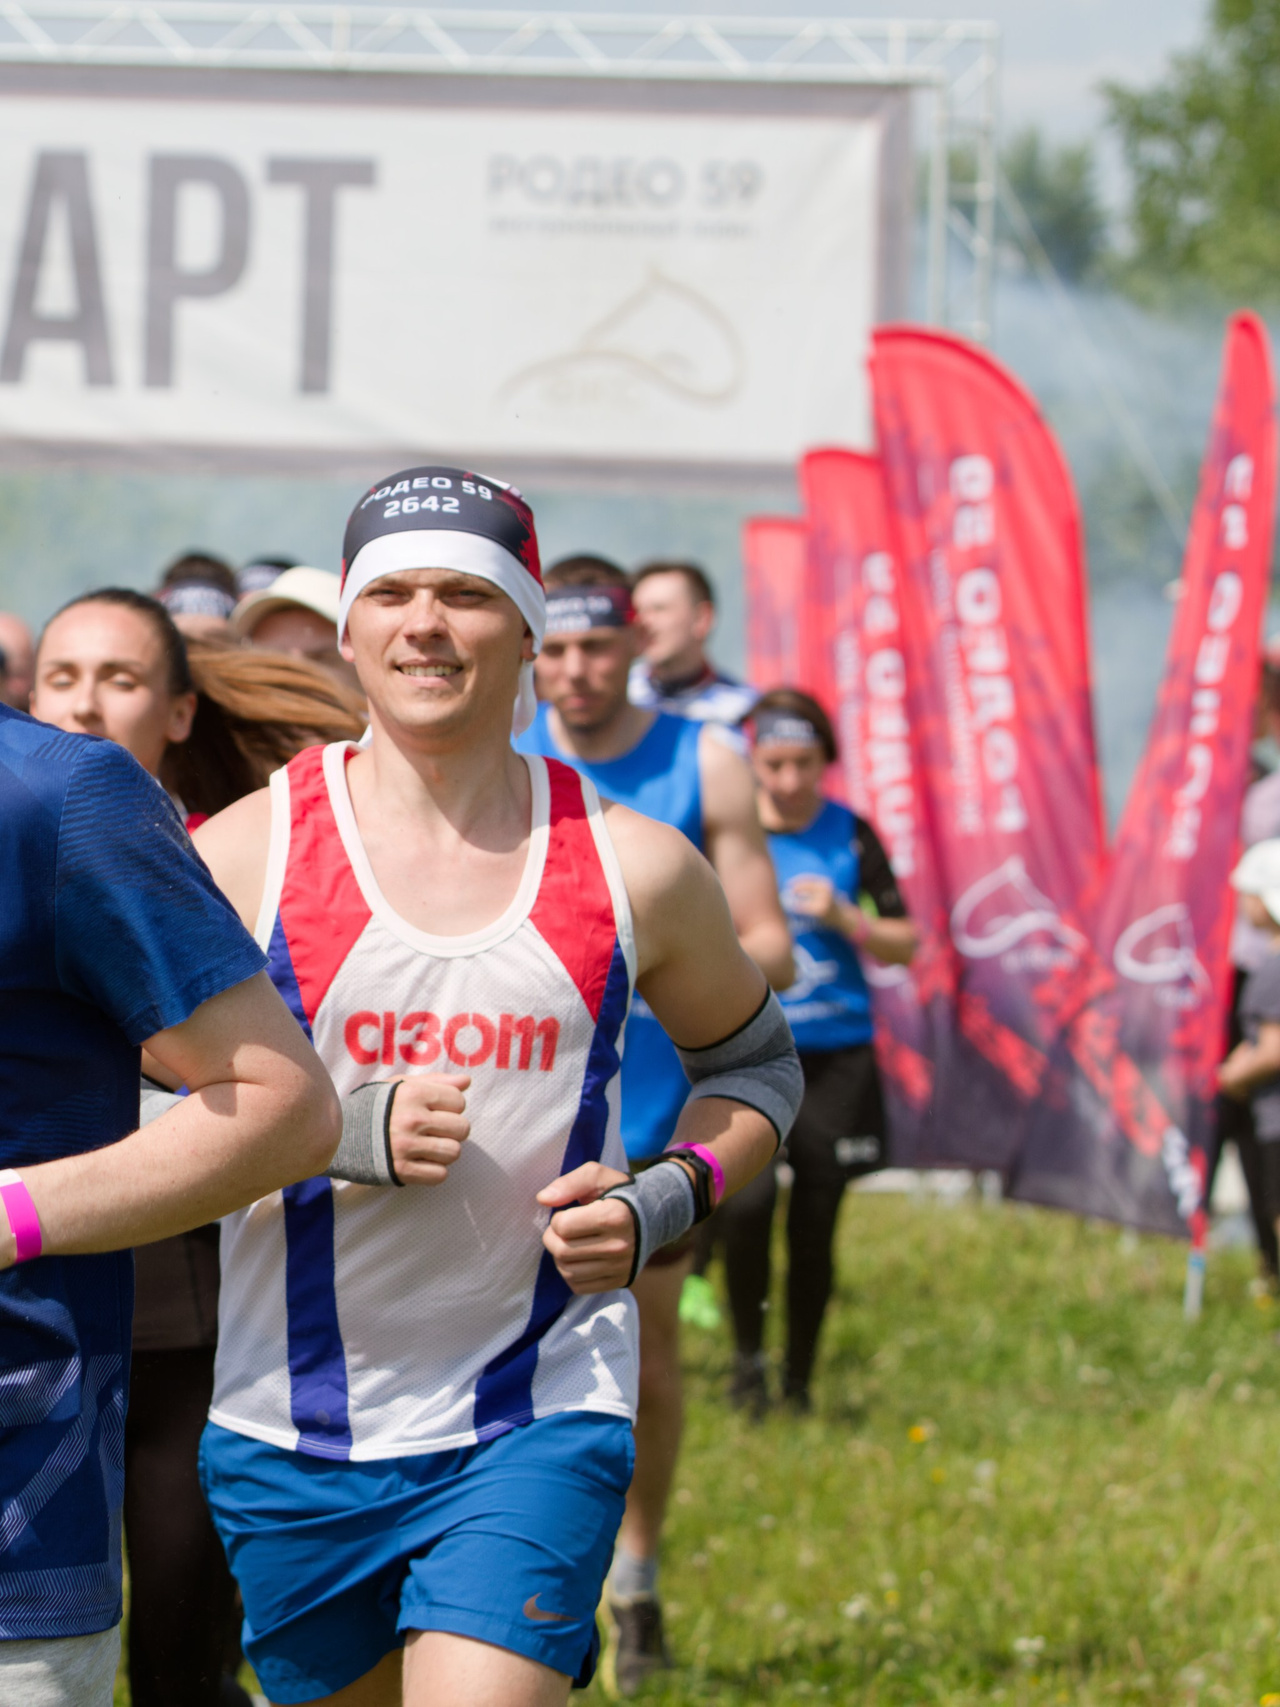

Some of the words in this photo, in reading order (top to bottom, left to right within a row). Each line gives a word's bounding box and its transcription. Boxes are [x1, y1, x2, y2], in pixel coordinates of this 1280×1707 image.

[487, 152, 686, 209] РОДЕО
[699, 158, 764, 210] 59
[360, 476, 452, 510] РОДЕО
[461, 480, 493, 502] 59
[383, 495, 460, 519] 2642
